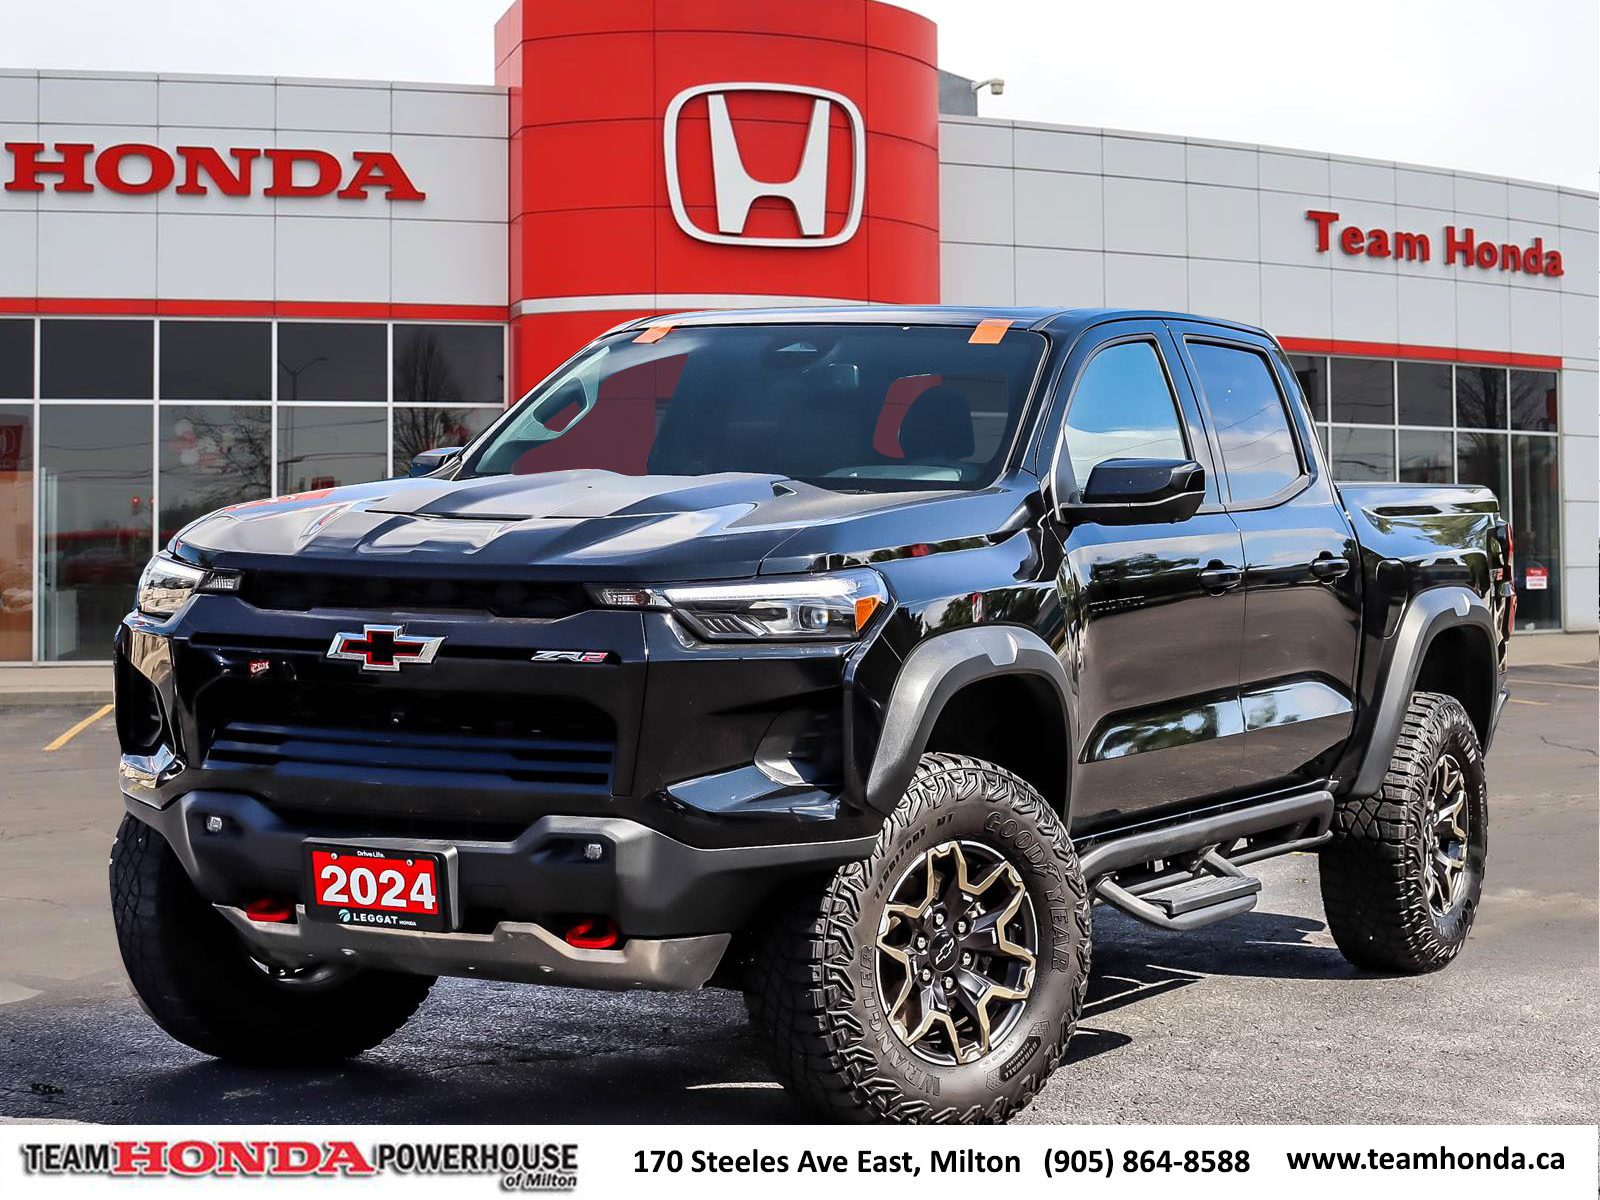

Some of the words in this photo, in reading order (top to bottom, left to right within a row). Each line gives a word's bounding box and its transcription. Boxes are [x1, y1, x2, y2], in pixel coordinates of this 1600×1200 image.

[4, 142, 427, 200] HONDA
[1306, 209, 1431, 262] Team
[1444, 225, 1565, 277] Honda
[530, 650, 609, 663] ZR2
[320, 865, 436, 910] 2024
[873, 825, 928, 899] TERRITORY
[352, 912, 399, 925] LEGGAT
[984, 811, 1070, 973] GOODYEAR
[860, 944, 942, 1097] WRANGLER
[1003, 1041, 1039, 1079] DURAWALL
